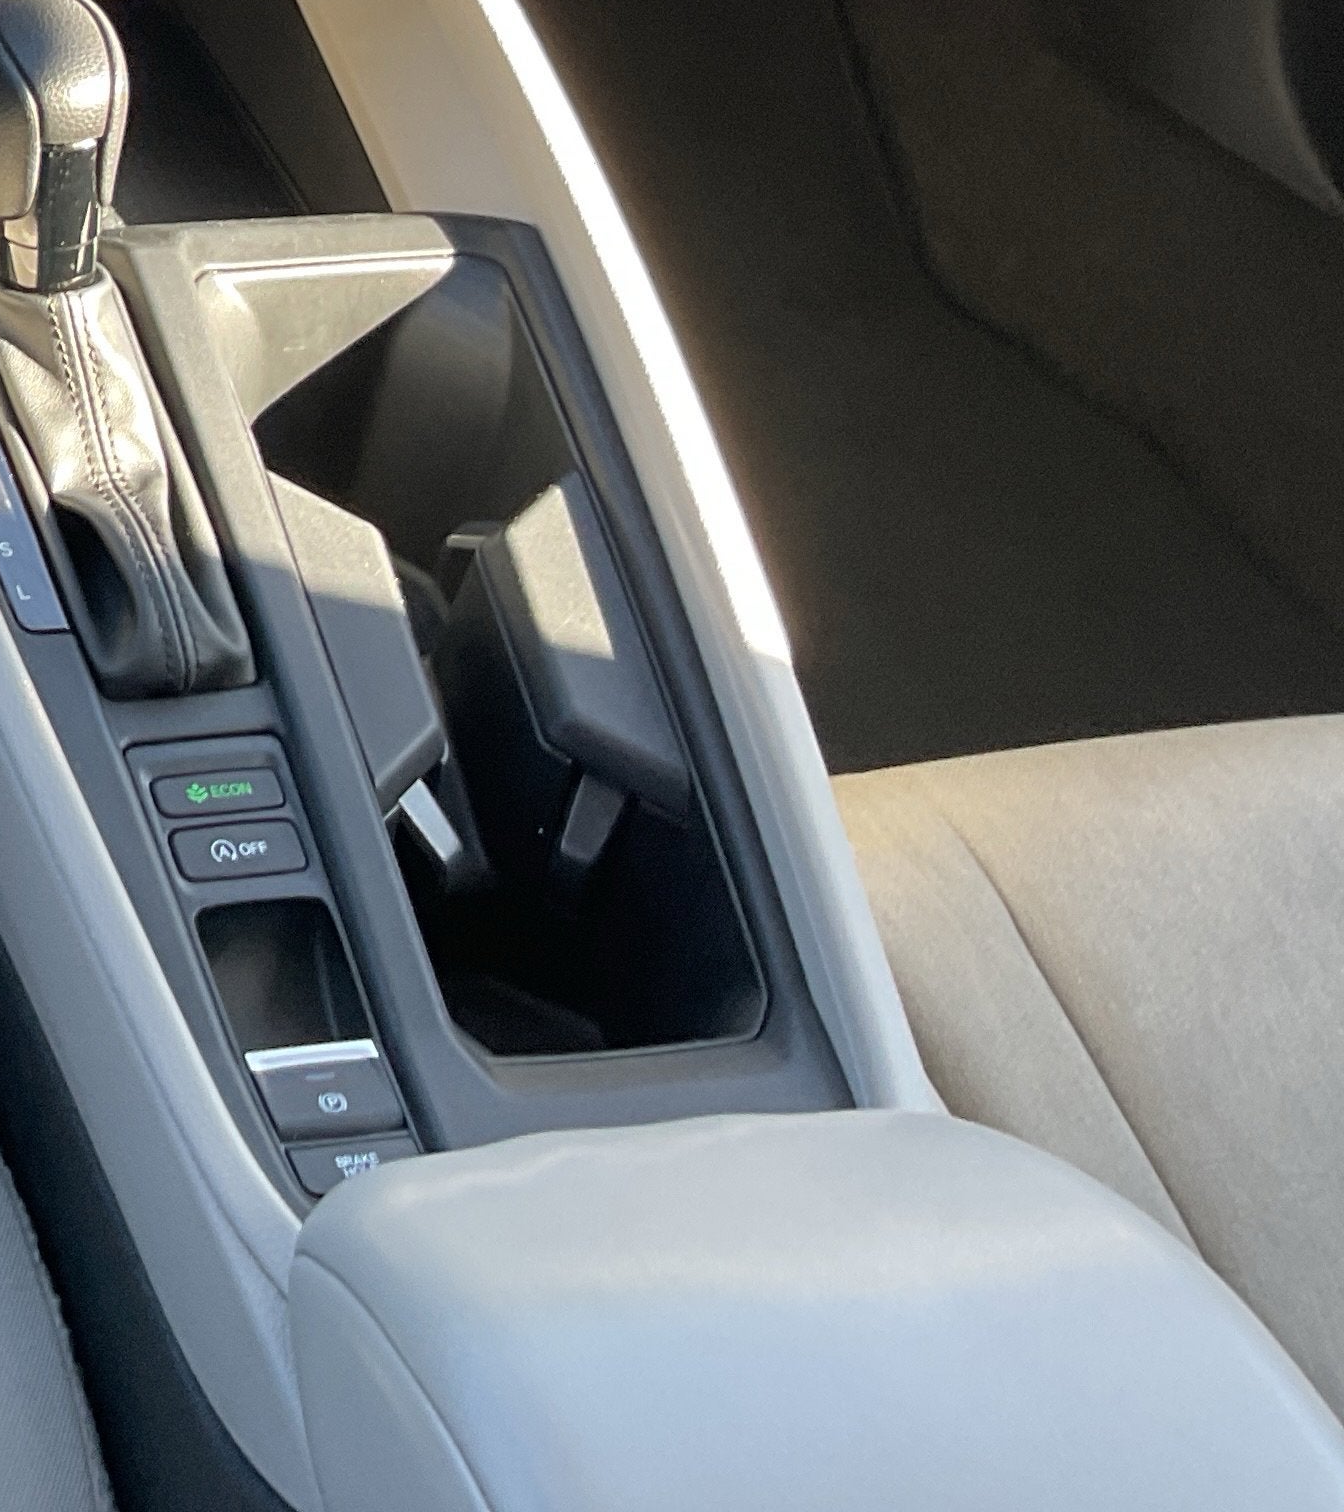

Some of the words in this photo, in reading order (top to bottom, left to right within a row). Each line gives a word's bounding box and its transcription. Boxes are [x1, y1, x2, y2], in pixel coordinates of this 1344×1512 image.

[0, 542, 14, 557] S
[16, 584, 32, 601] L
[209, 782, 252, 798] ECON
[238, 840, 268, 856] OFF
